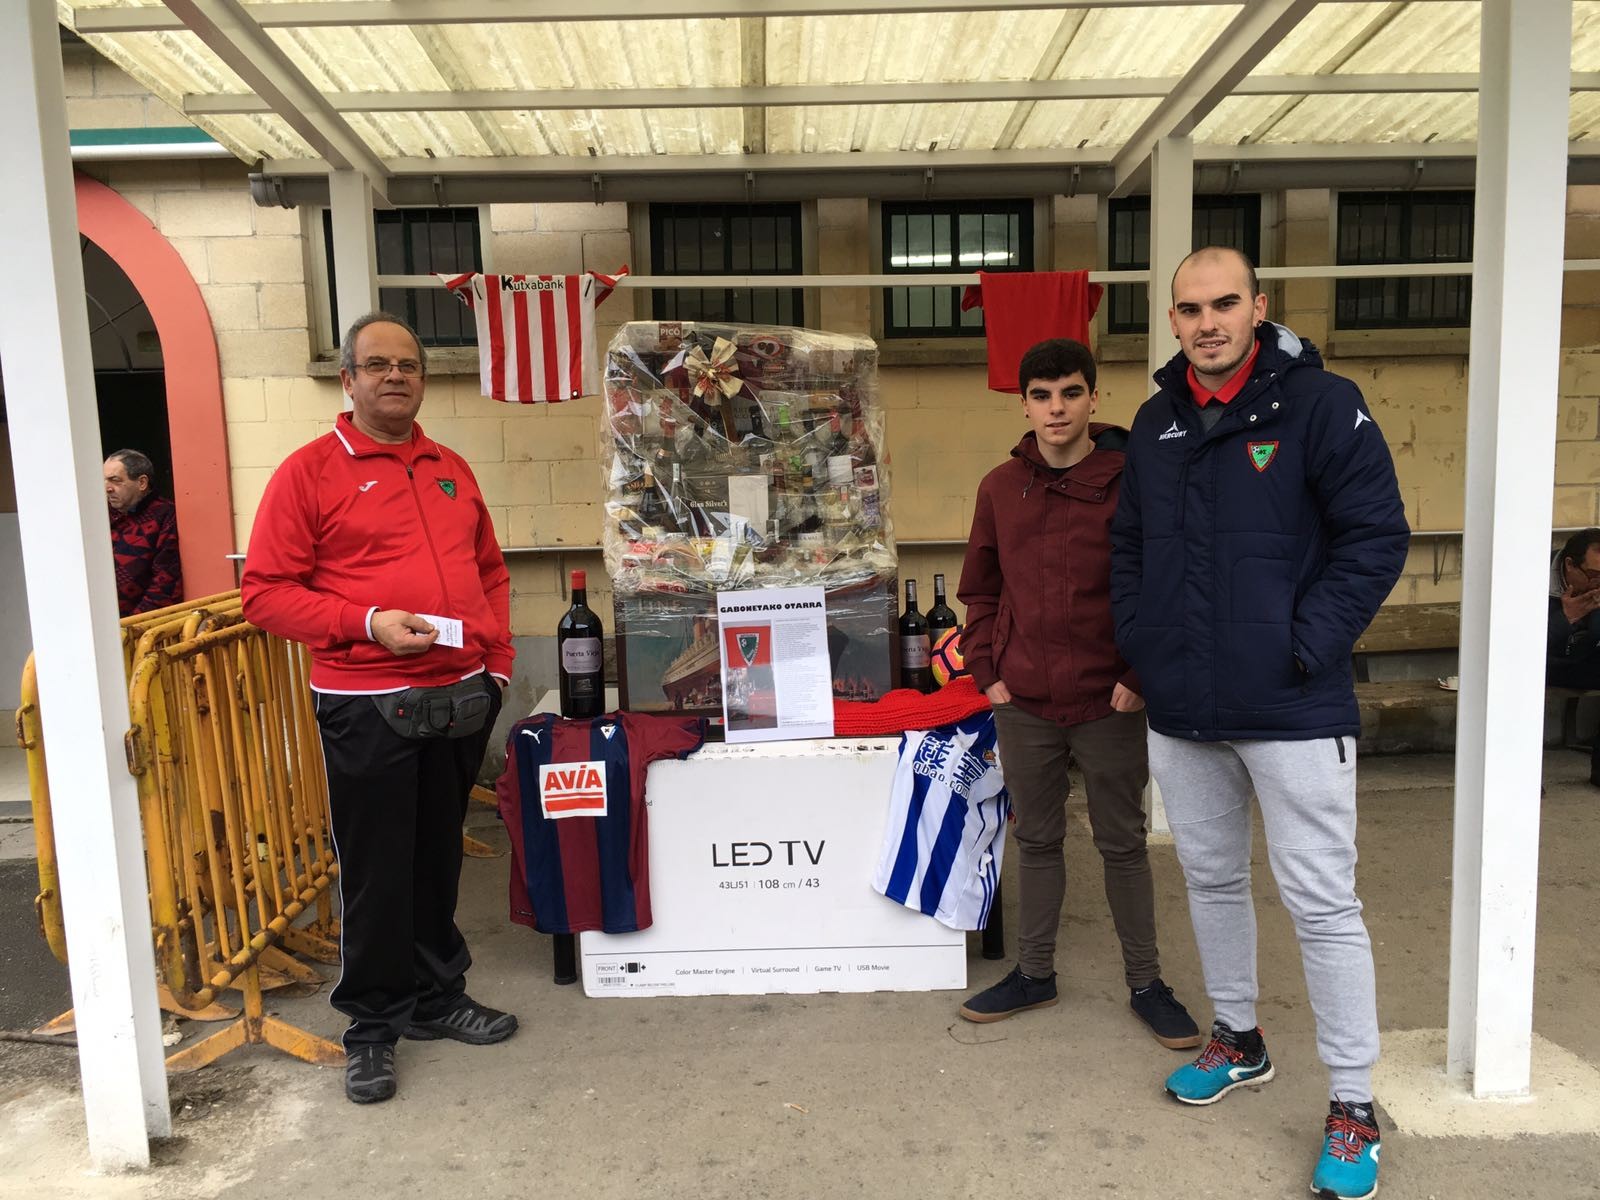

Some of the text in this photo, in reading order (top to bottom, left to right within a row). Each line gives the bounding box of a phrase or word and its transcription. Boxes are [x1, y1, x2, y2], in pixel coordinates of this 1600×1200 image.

[501, 275, 564, 291] Kutxabank
[1158, 430, 1188, 441] MERCURY
[720, 601, 823, 613] GABONETAKO OTARRA
[712, 840, 825, 867] LED TV
[758, 879, 780, 889] 108
[805, 878, 820, 888] 43
[715, 967, 736, 976] Engine
[751, 966, 771, 974] Virtual
[772, 965, 800, 973] Surround
[832, 964, 842, 972] TV
[871, 963, 890, 971] Movie
